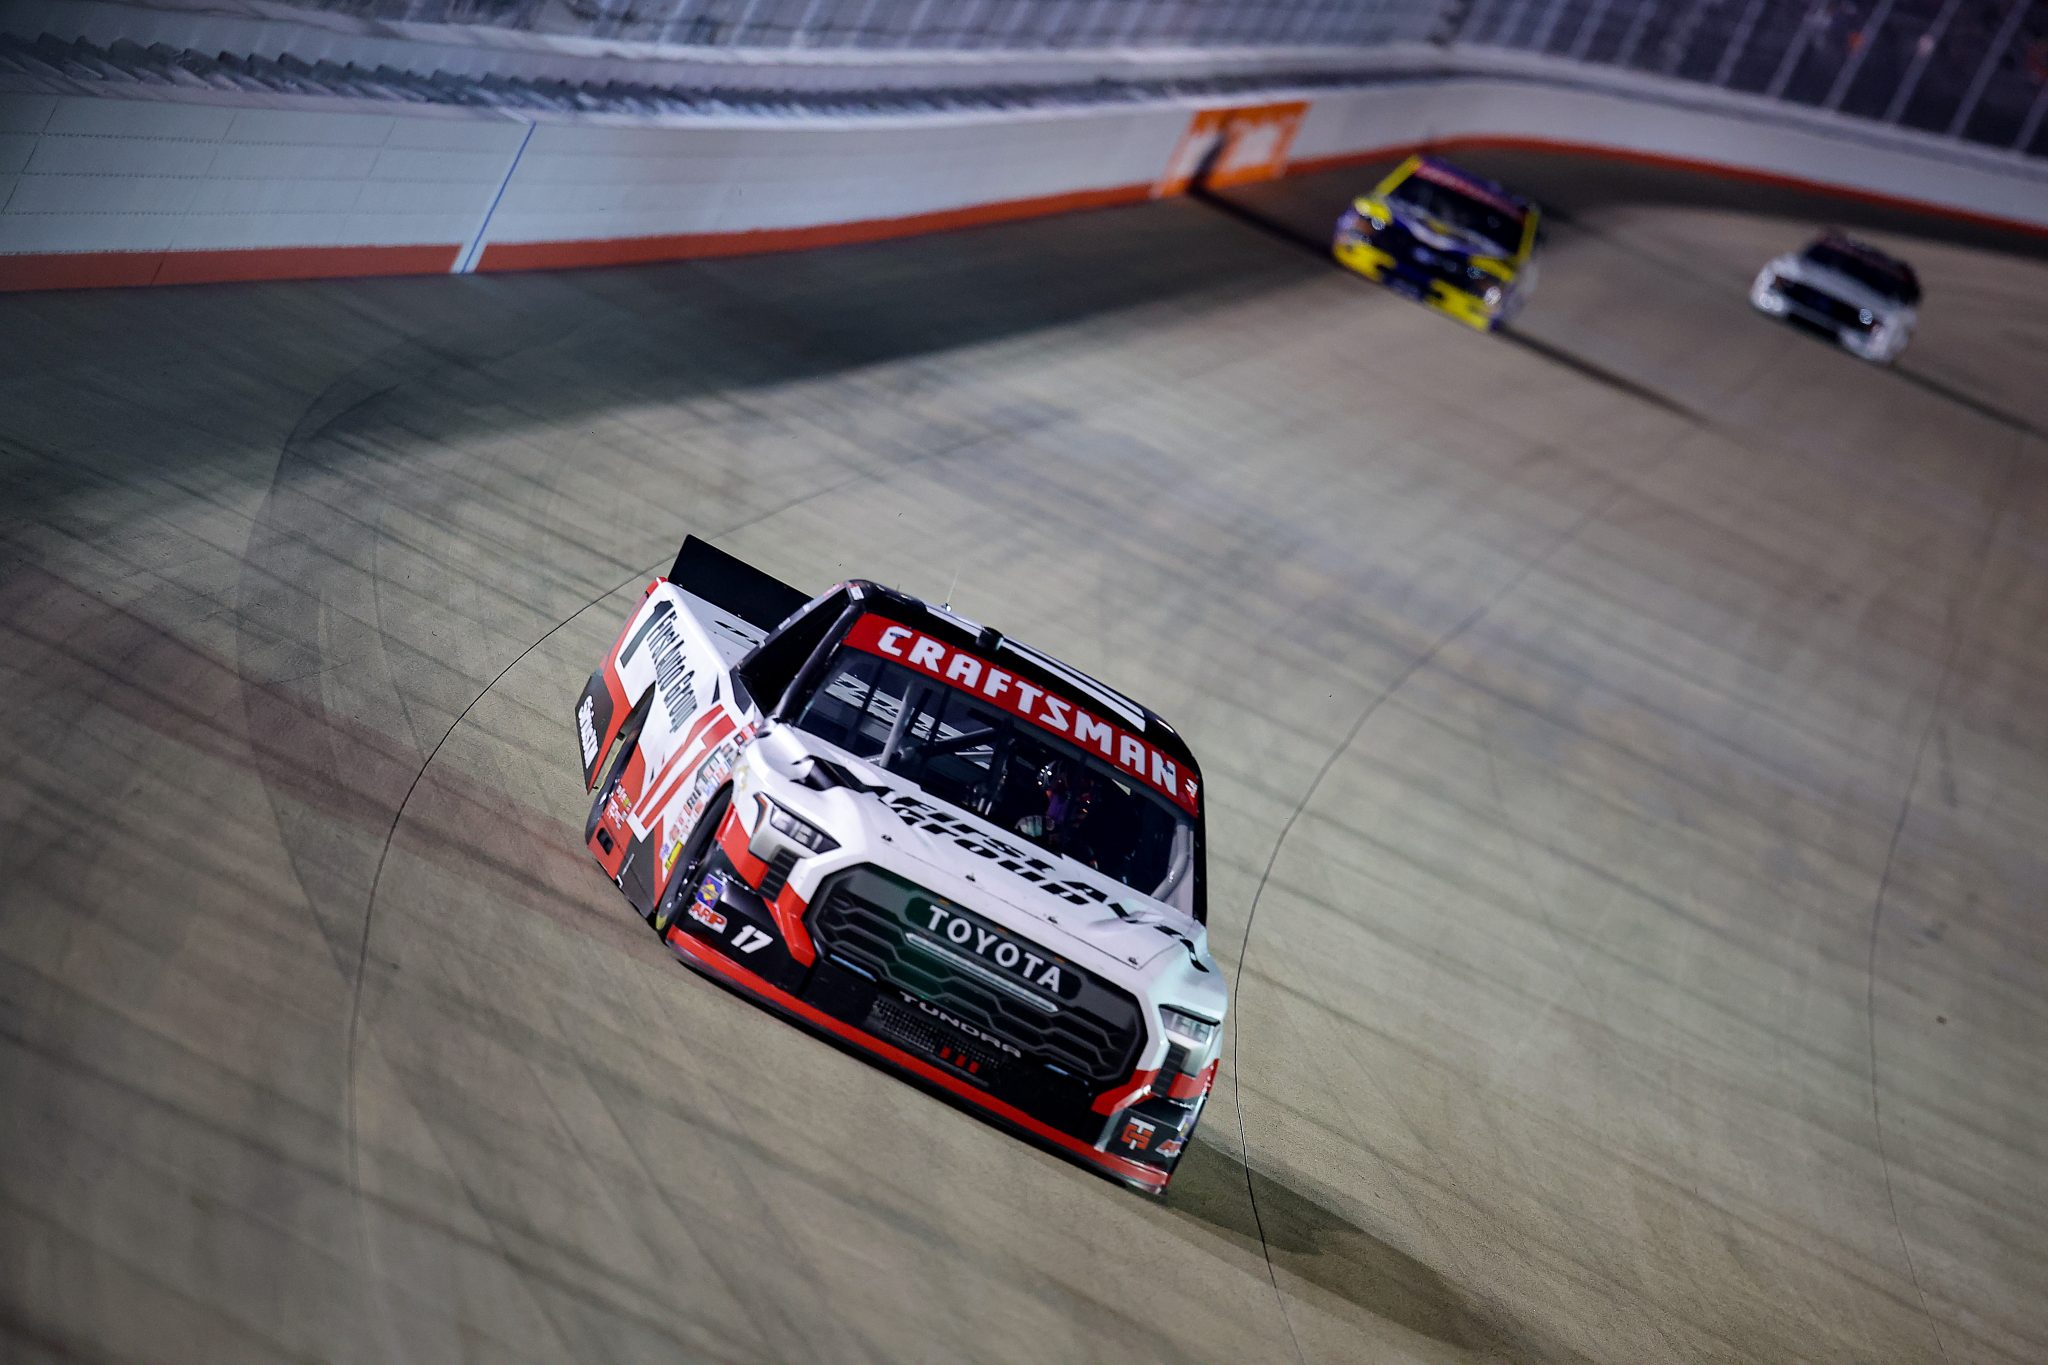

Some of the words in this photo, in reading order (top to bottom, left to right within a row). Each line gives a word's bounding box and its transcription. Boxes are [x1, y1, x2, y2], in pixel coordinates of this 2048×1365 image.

[647, 609, 680, 665] First
[656, 639, 687, 693] Auto
[664, 670, 698, 734] Group
[877, 625, 1177, 795] CRAFTSMAN
[730, 924, 774, 953] 17
[928, 905, 1062, 995] TOYOTA
[900, 990, 1021, 1058] TUNDRA
